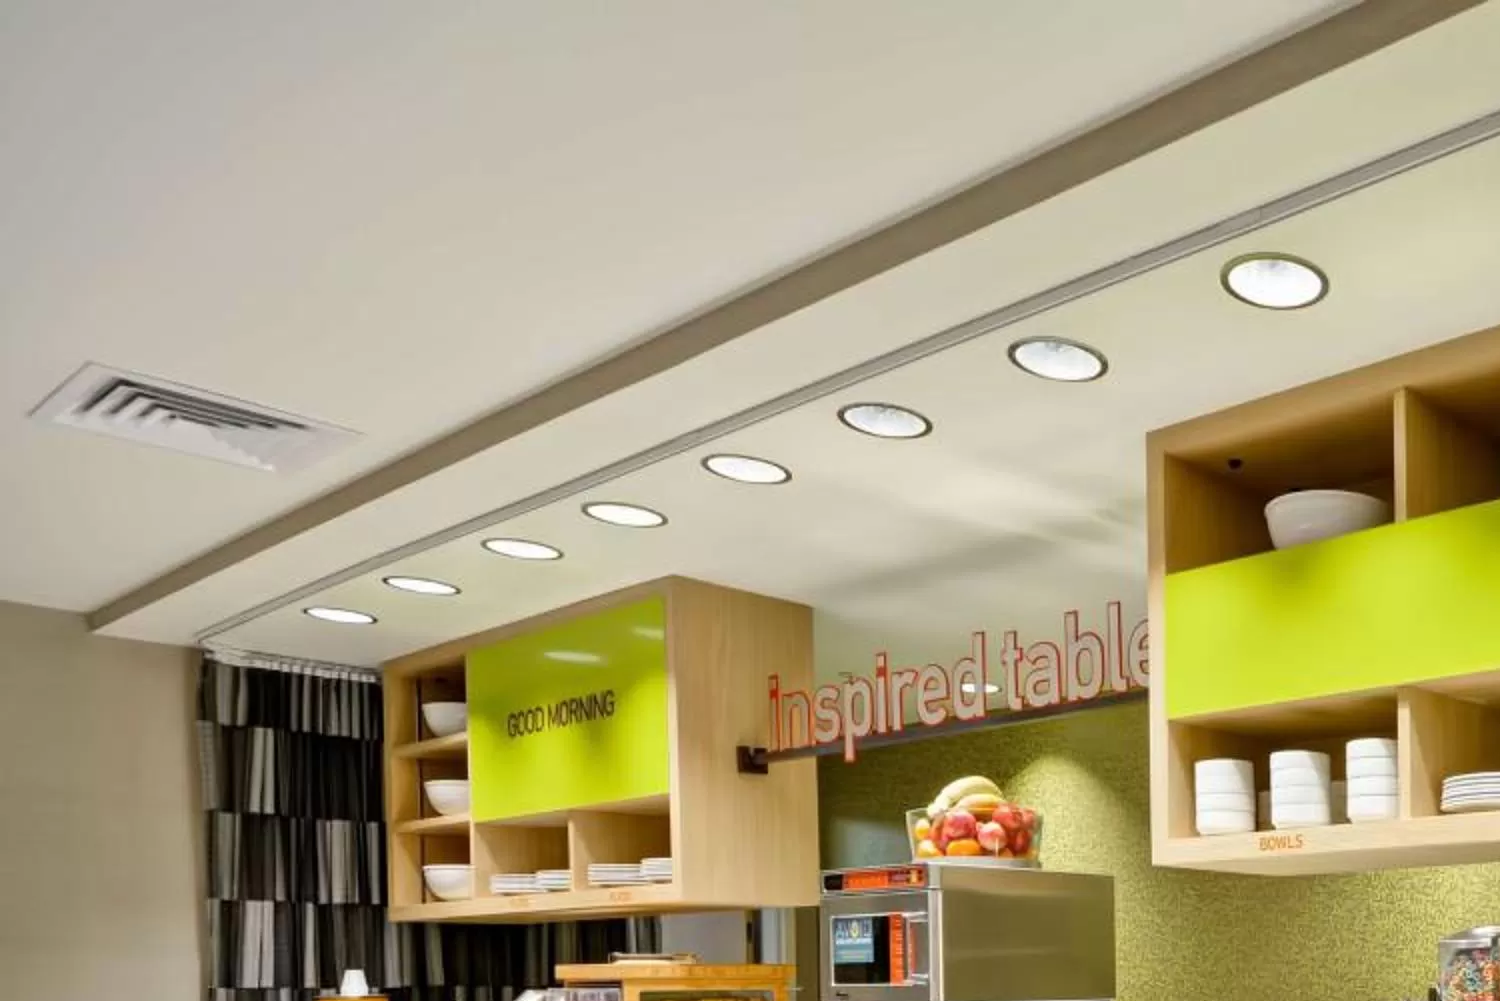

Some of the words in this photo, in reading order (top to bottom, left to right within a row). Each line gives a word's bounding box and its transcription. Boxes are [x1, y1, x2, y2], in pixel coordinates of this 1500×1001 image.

[507, 706, 545, 738] GOOD
[547, 689, 615, 731] MORNING
[768, 630, 986, 763] inspired
[1259, 833, 1304, 851] BOWLS
